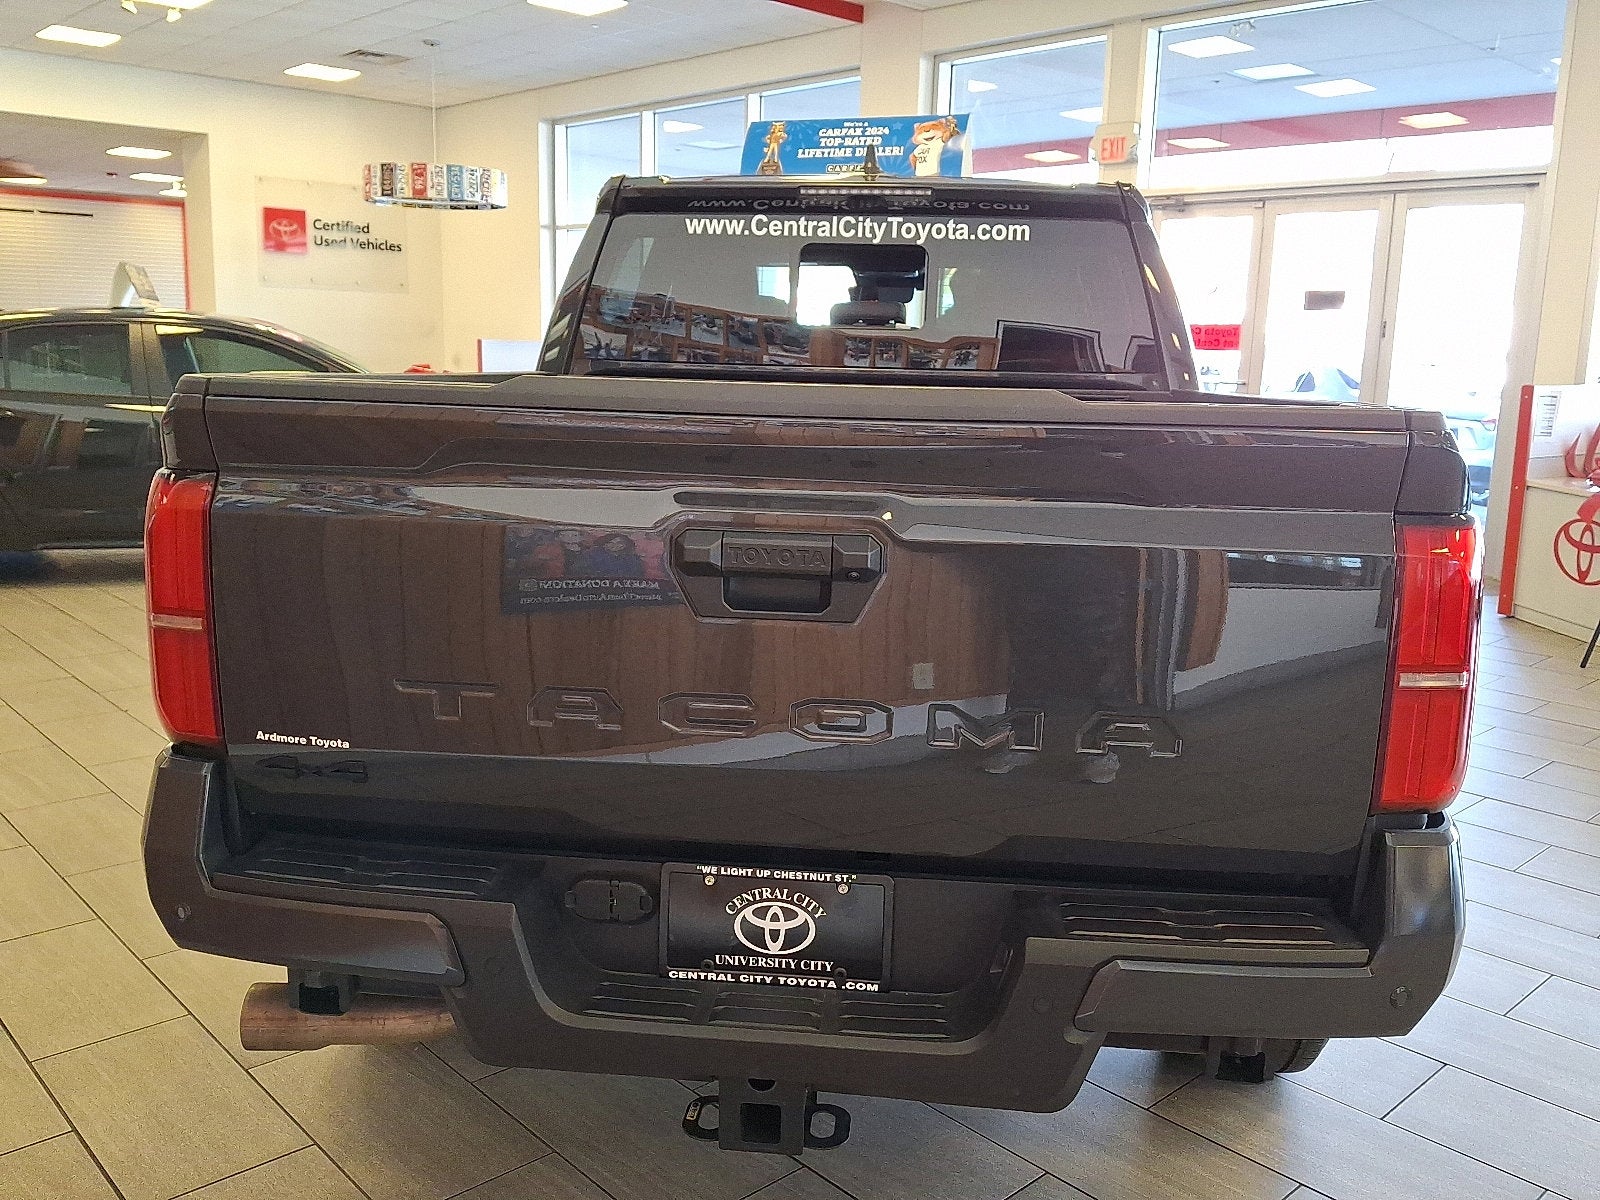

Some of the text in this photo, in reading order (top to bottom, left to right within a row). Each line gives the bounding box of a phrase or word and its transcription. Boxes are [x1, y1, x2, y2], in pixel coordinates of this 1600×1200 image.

[818, 126, 890, 137] CARFAX 2024
[819, 136, 883, 147] TOP-RATED
[1101, 136, 1126, 161] EXIT
[797, 148, 853, 158] LIFETIME
[313, 218, 370, 234] Certified
[685, 213, 1031, 244] www.CentralCityToyota.com
[314, 235, 402, 252] Used Vehicles
[727, 546, 827, 568] TOYOTA
[393, 678, 1184, 758] TACOMA
[256, 730, 350, 749] Ardmore Toyota
[720, 867, 754, 878] LIGHT
[756, 869, 771, 878] UP
[773, 870, 832, 882] CHESTNUT
[725, 887, 828, 920] CENTRAL CITY
[715, 954, 834, 972] UNIVERSITY CITY
[668, 970, 880, 992] CENTRAL CITY TOYOTA .COM
